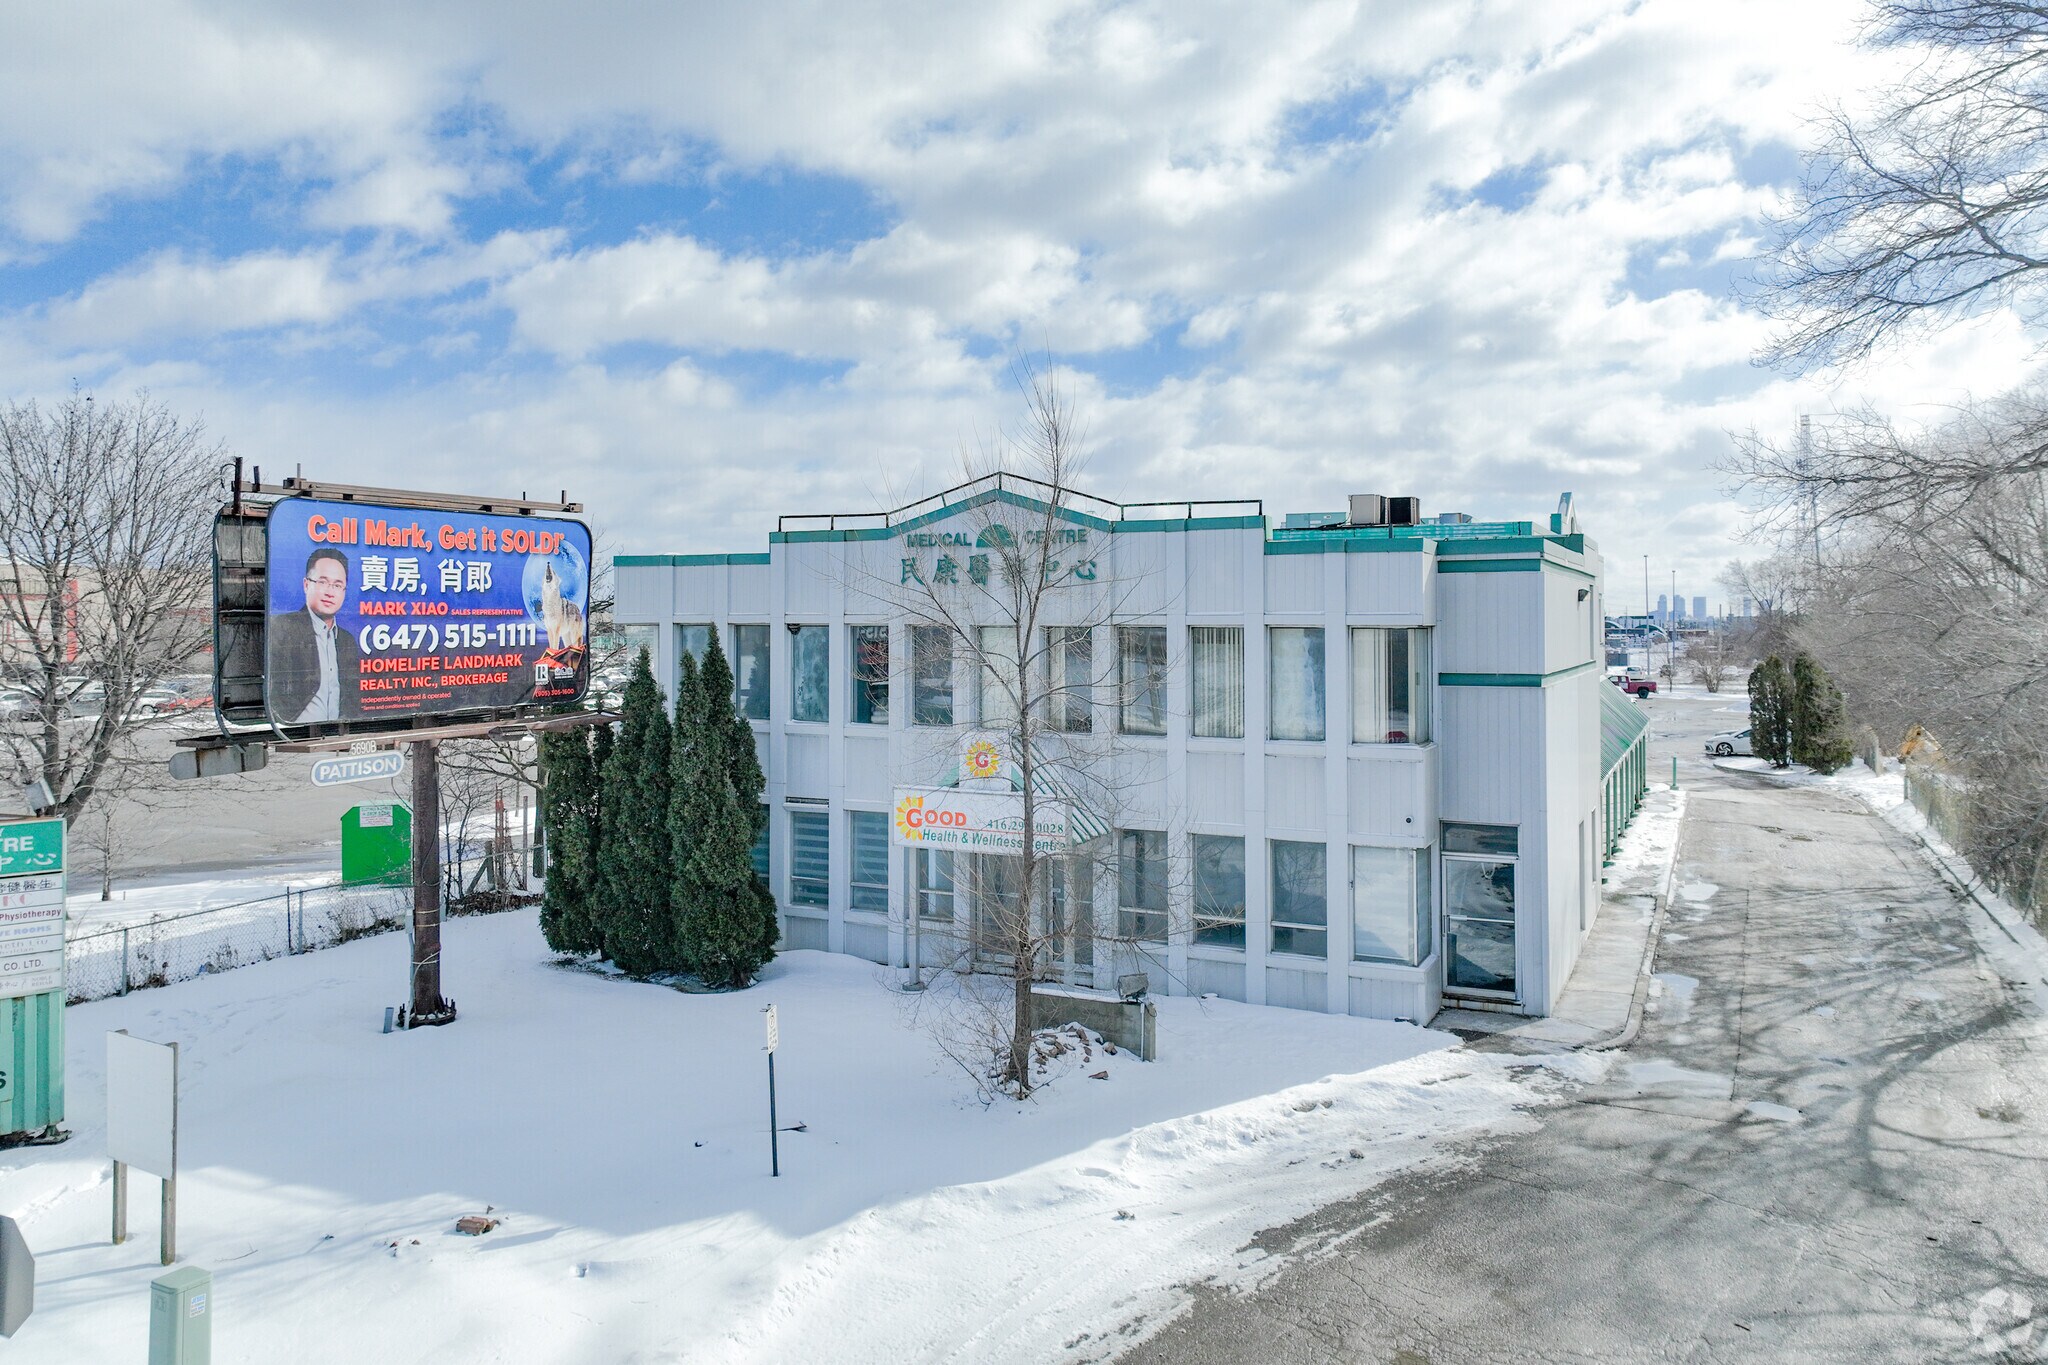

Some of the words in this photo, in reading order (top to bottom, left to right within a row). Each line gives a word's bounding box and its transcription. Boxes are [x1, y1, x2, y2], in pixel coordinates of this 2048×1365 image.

[308, 515, 358, 544] Call
[365, 518, 433, 553] Mark,
[438, 524, 477, 551] Get
[481, 525, 497, 552] it
[1025, 528, 1088, 545] CETRE
[901, 553, 1097, 587] 民康醫中心
[360, 601, 407, 616] MARK
[411, 601, 448, 616] XIAO
[451, 608, 471, 616] SALES
[472, 608, 523, 616] REPRESENTATIVE
[359, 623, 440, 655] (647)
[443, 623, 537, 649] 515-1111
[360, 656, 440, 673] HOMELIFE
[444, 653, 523, 670] LANDMARK
[360, 677, 409, 691] REALTY
[411, 676, 438, 689] INC.,
[441, 672, 508, 686] BROKERAGE
[361, 695, 401, 704] Independently
[402, 693, 421, 701] owned
[427, 692, 452, 700] operated
[351, 740, 377, 756] 5690B
[319, 757, 397, 780] PATTISON
[906, 808, 967, 828] GOOD
[0, 835, 34, 853] RE
[923, 828, 958, 844] Health
[961, 831, 969, 844] &
[972, 832, 1024, 849] Wellness
[0, 908, 62, 922] Physiotherapy
[14, 924, 52, 936] ROOMS
[4, 962, 21, 972] CO.
[24, 959, 44, 969] LTD.
